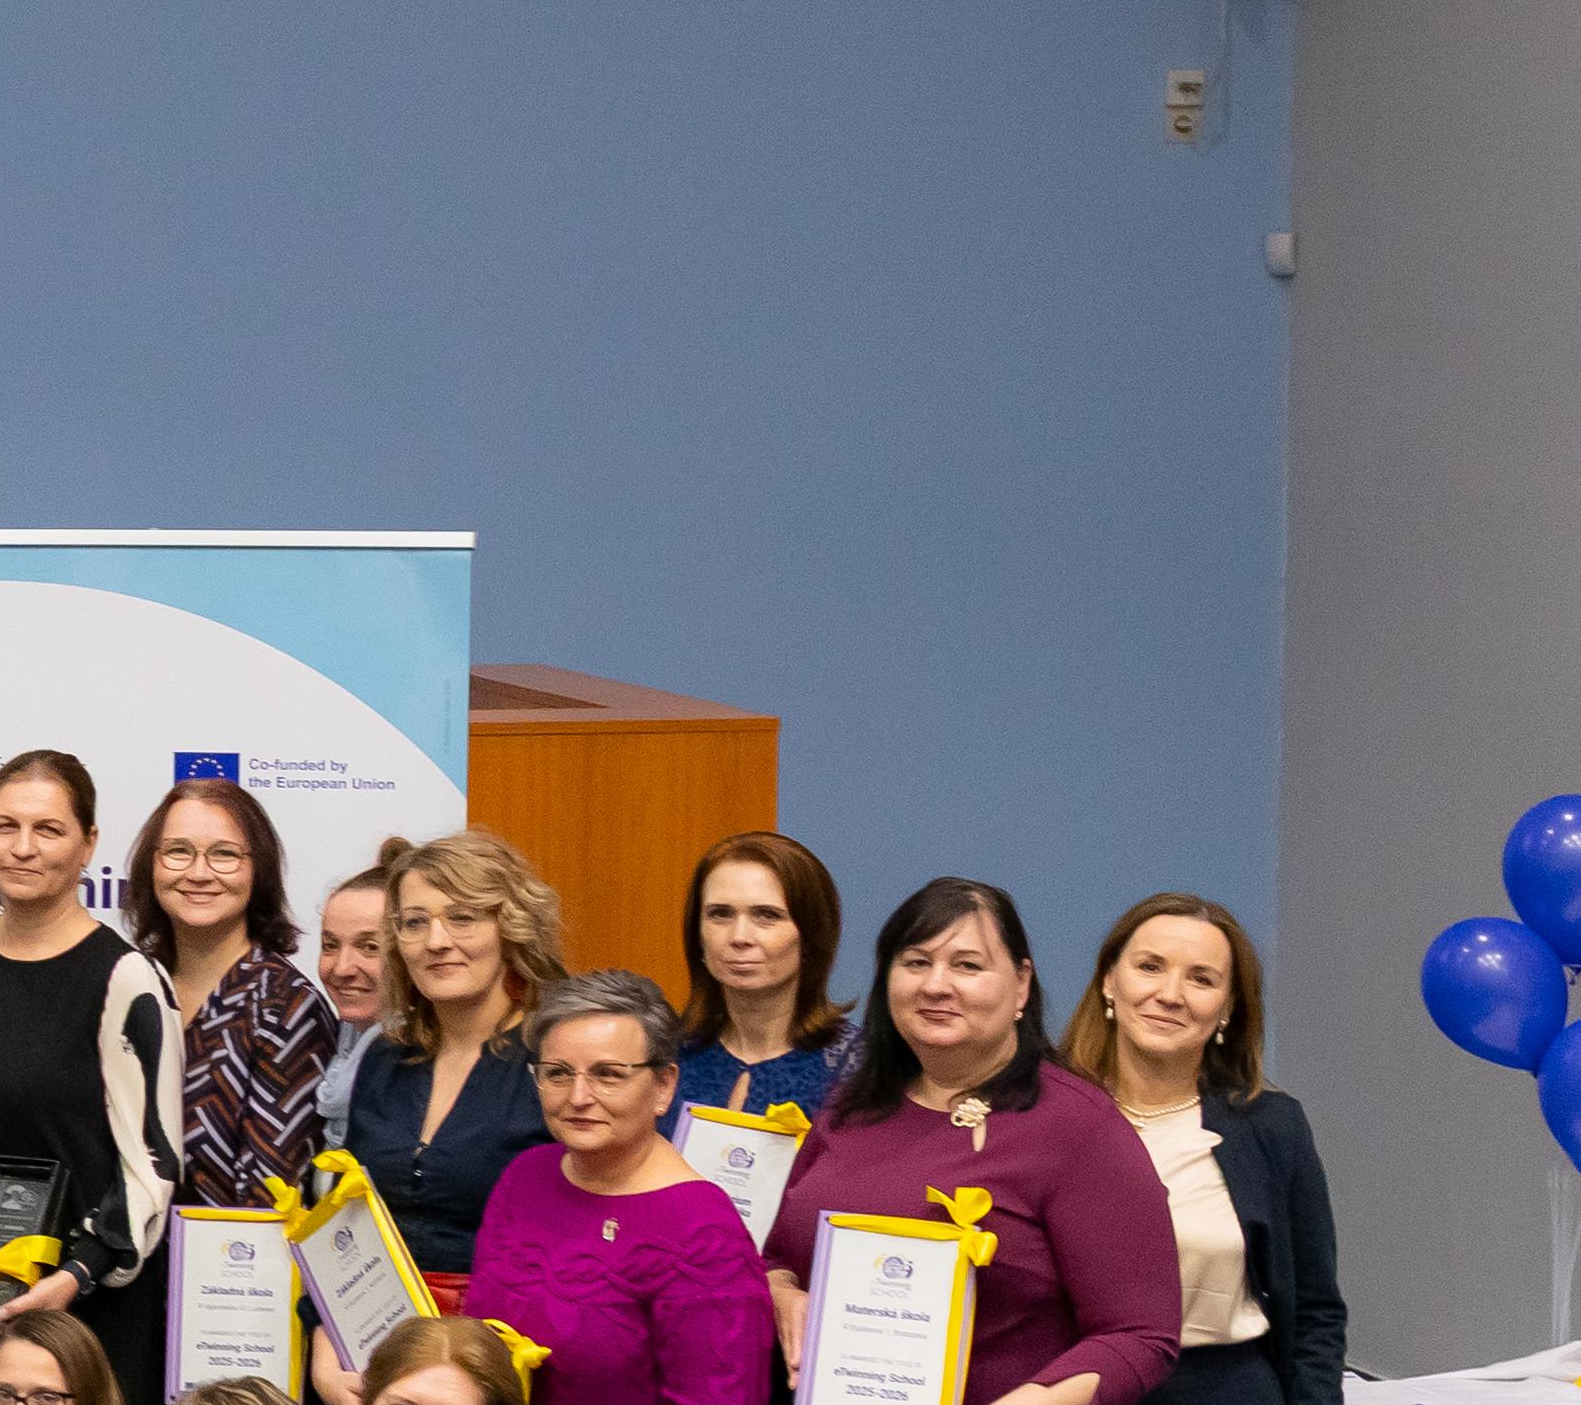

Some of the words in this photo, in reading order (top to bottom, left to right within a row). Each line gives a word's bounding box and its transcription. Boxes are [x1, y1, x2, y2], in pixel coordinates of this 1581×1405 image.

[248, 758, 326, 772] Co-funded
[331, 758, 349, 775] by
[248, 776, 271, 789] the
[276, 776, 347, 791] European
[352, 778, 396, 791] Union
